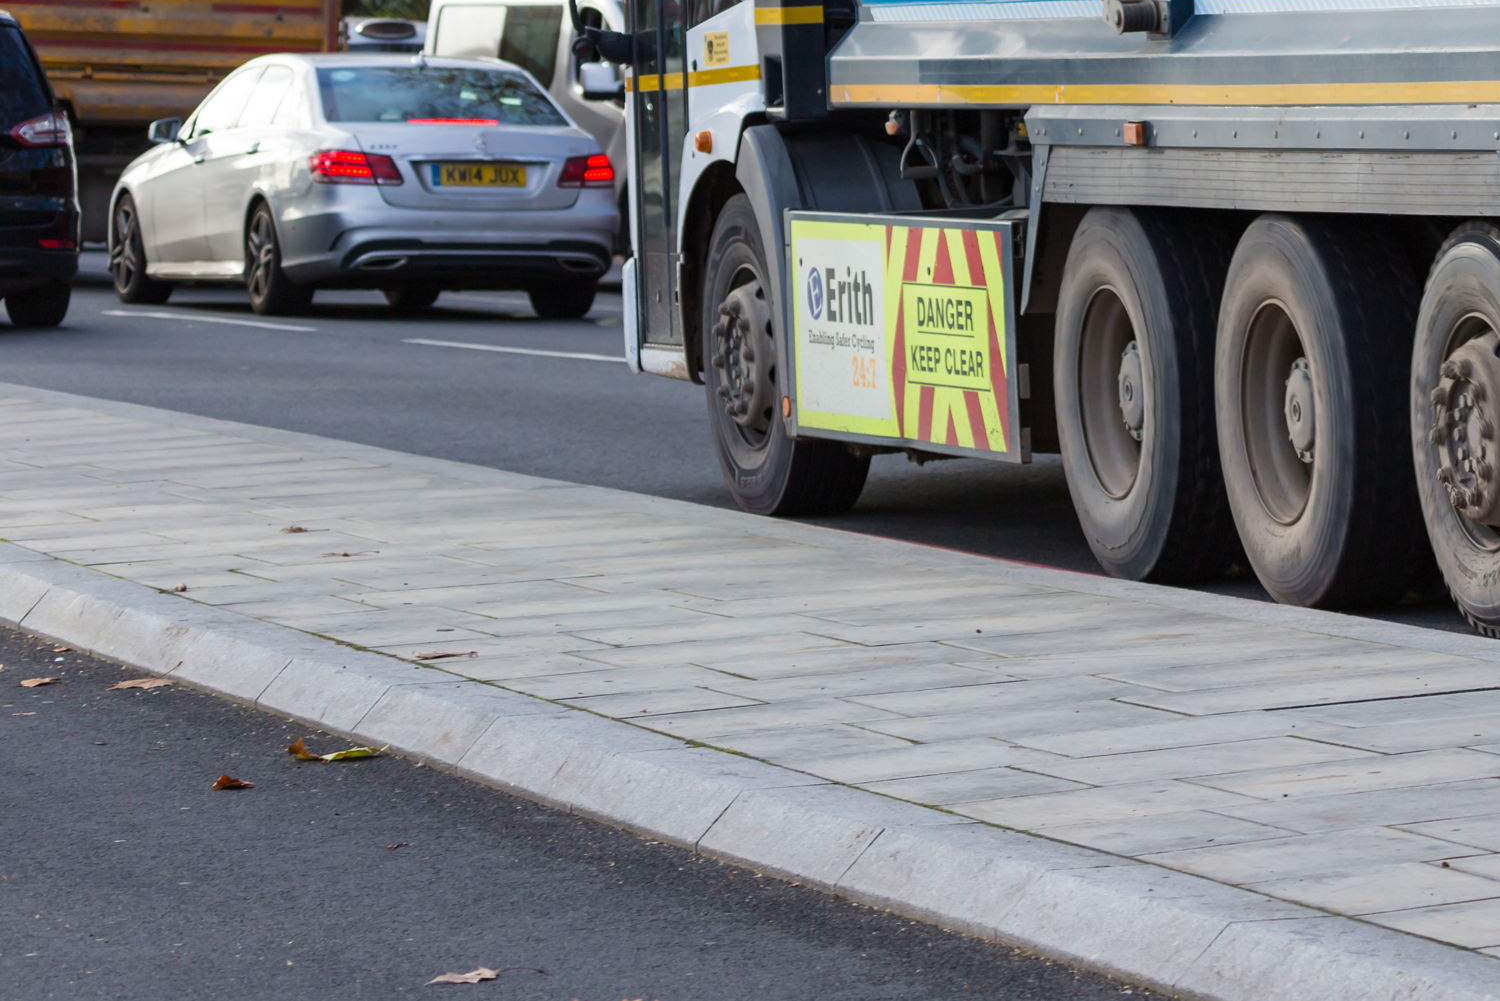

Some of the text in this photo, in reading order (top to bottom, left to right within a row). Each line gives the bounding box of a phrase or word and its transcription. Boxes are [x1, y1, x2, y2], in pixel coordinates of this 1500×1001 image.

[488, 166, 520, 184] JUX
[825, 265, 874, 326] Erith
[917, 296, 974, 331] DANGER
[808, 329, 875, 354] Enabling Safer Cycling
[852, 355, 876, 388] 24:7
[910, 345, 984, 378] KEEP CLEAR
